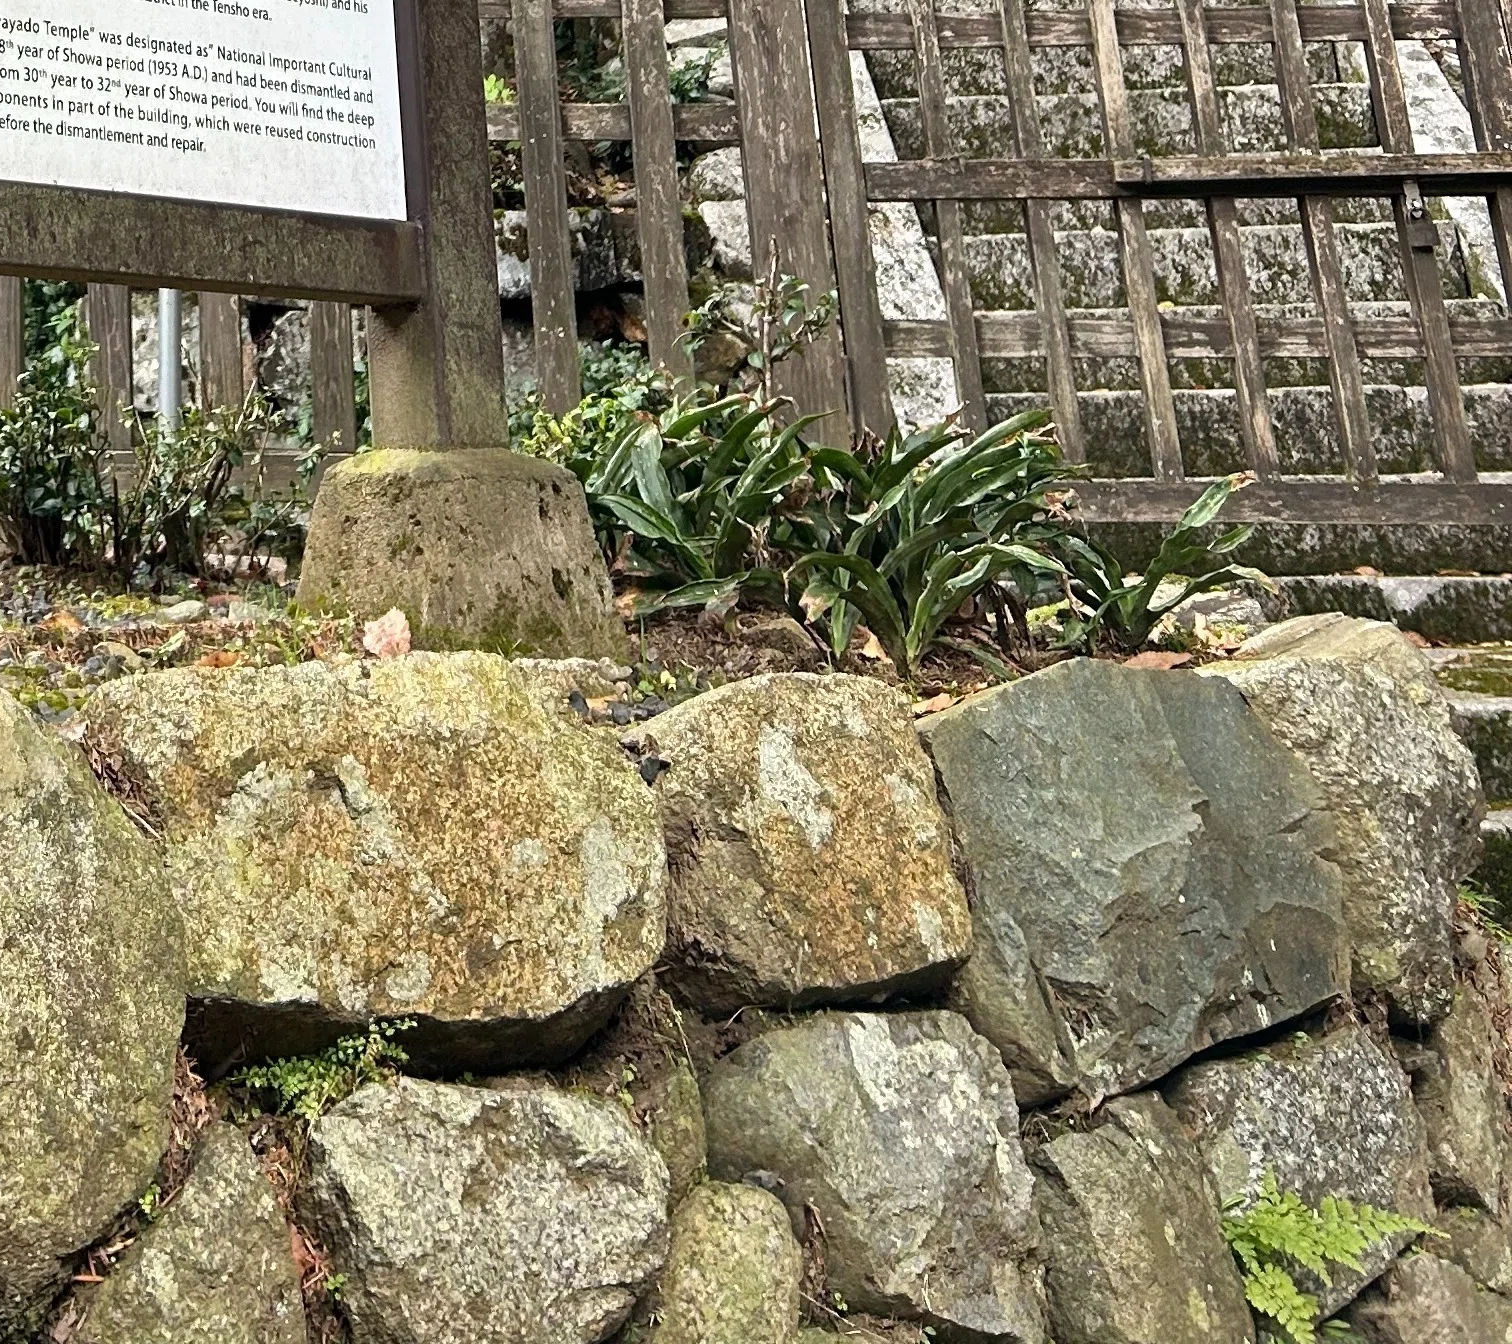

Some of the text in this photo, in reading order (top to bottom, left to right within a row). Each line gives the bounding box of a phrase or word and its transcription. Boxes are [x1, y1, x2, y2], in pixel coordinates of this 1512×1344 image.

[250, 6, 274, 23] era.
[15, 43, 45, 62] year
[45, 44, 62, 63] of
[61, 46, 104, 68] Showa
[104, 54, 146, 74] period
[147, 57, 179, 78] (1953
[210, 67, 234, 86] and
[234, 69, 258, 89] had
[258, 72, 289, 94] been
[289, 77, 352, 102] dismantled
[352, 88, 375, 106] and
[97, 30, 124, 47] was
[124, 30, 194, 57] designated
[216, 44, 267, 68] National
[267, 51, 328, 76] Important
[327, 60, 373, 83] Cultural
[31, 115, 54, 136] the
[54, 118, 145, 147] dismantlement
[145, 131, 170, 150] and
[170, 135, 208, 156] repair.
[51, 93, 65, 113] in
[66, 99, 96, 118] part
[96, 99, 113, 118] of
[112, 101, 135, 121] the
[136, 103, 193, 132] building,
[193, 112, 231, 133] which
[231, 120, 263, 137] were
[263, 124, 305, 143] reused
[305, 129, 377, 151] construction
